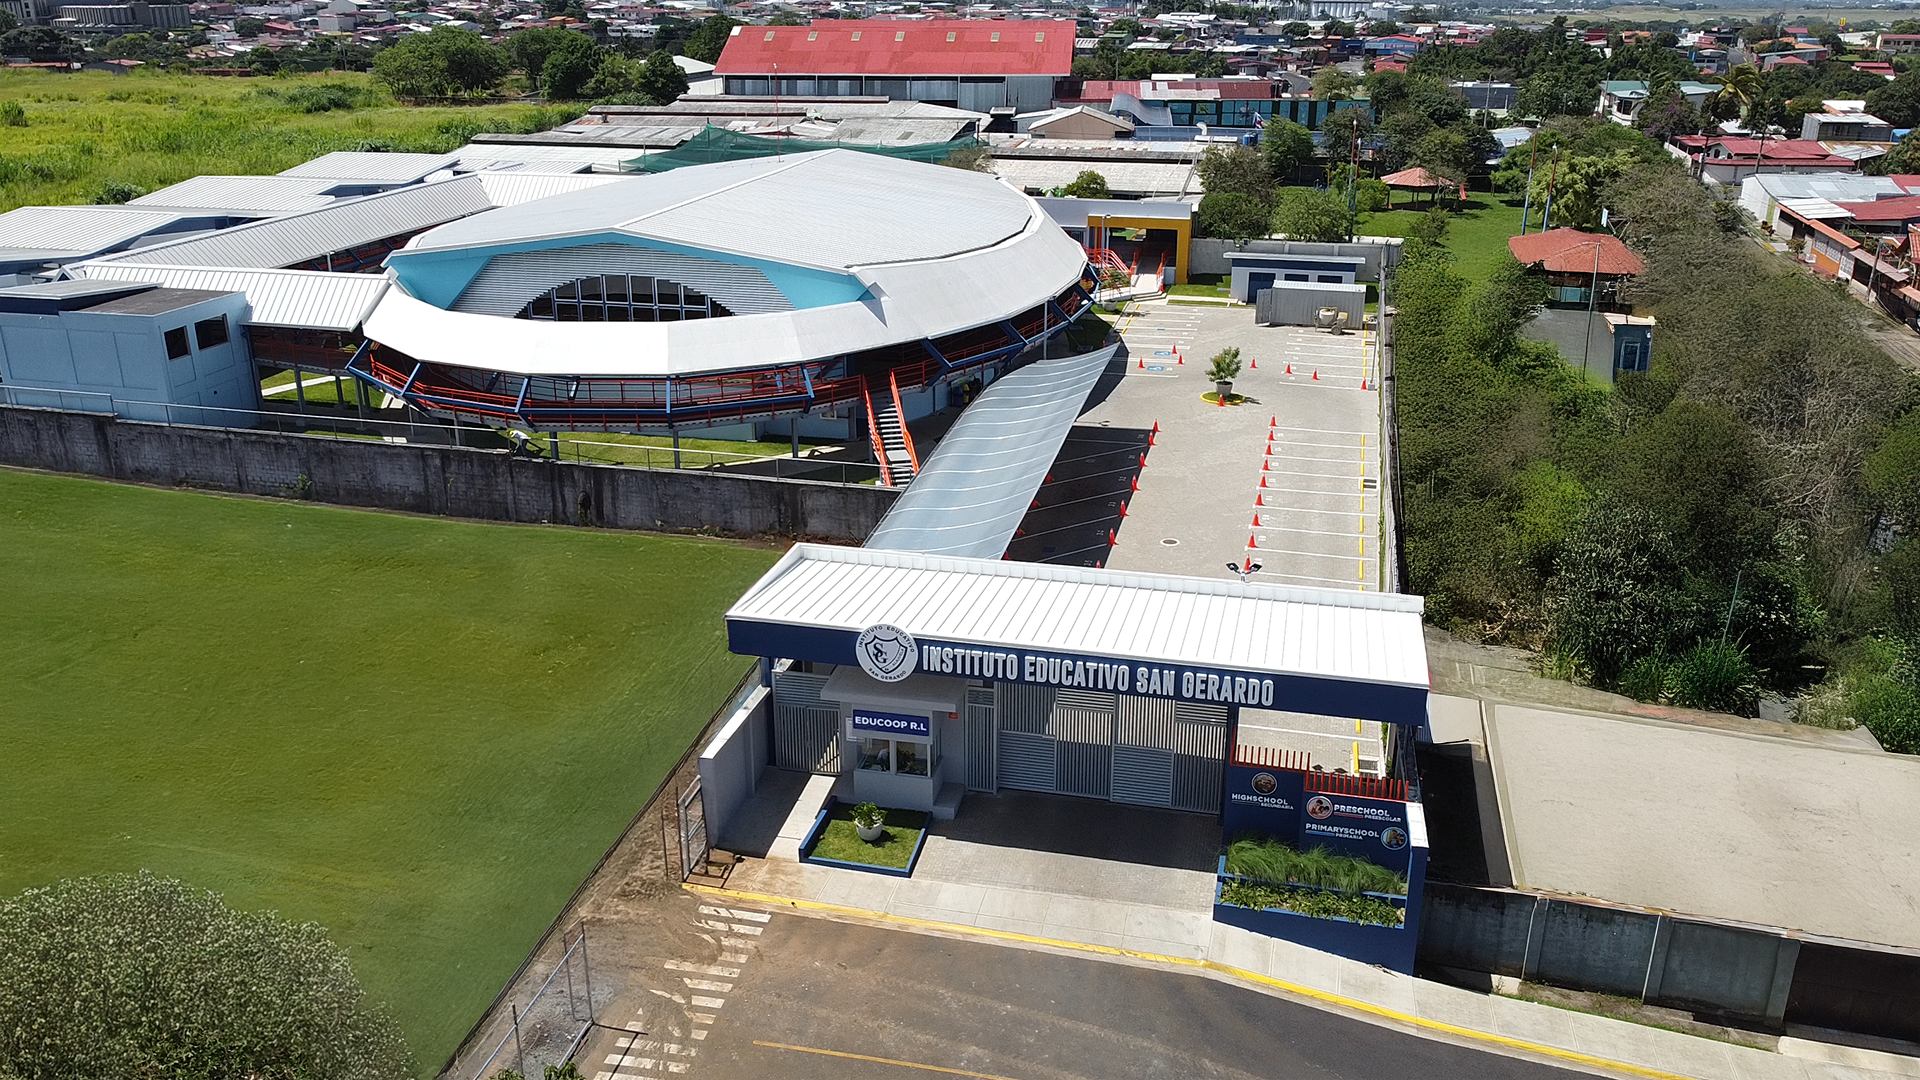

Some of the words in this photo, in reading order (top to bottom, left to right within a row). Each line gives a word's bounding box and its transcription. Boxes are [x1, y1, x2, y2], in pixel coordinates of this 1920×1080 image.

[858, 625, 883, 648] INSTITUTO
[886, 626, 915, 653] EDUCATIVO
[869, 667, 879, 677] SAN
[880, 670, 907, 680] GERARDO
[922, 645, 1018, 680] INSTITUTO
[1024, 655, 1130, 692] EDUCATIVO
[1136, 666, 1176, 696] SAN
[1181, 671, 1274, 706] GERARDO
[854, 716, 908, 729] EDUCOOP
[910, 721, 927, 731] R.L
[1231, 793, 1289, 805] HIGHSCHOOL
[1260, 802, 1294, 810] SECUNDARIA
[1334, 804, 1390, 817] PRESCHOOL
[1364, 814, 1402, 823] PREESCOLAR
[1305, 823, 1380, 838] PRIMARYSCHOOL
[1335, 832, 1363, 840] PRIMARIA
